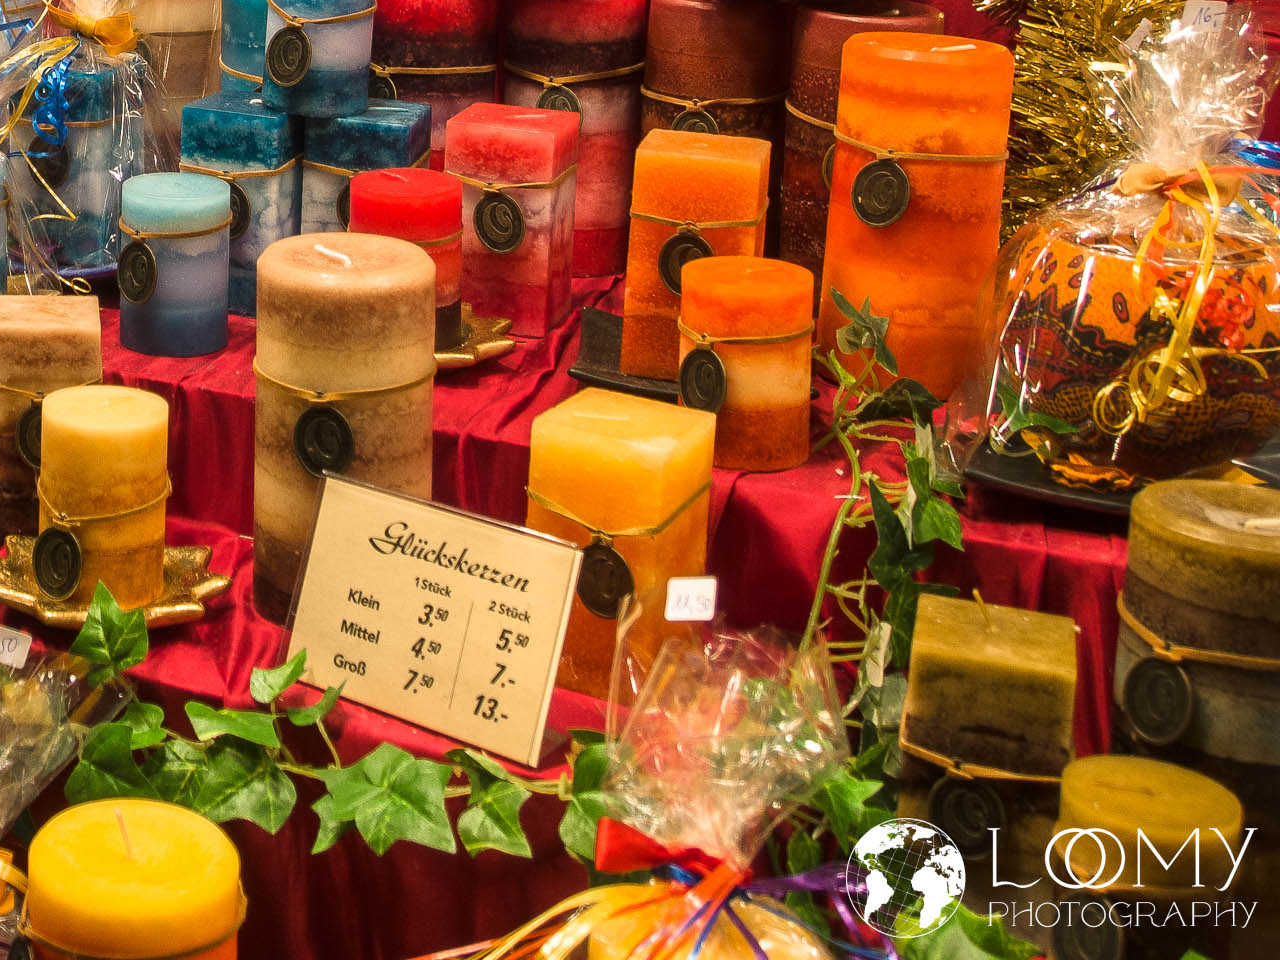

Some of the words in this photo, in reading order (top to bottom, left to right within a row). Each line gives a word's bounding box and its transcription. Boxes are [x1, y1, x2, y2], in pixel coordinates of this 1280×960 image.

[368, 521, 531, 593] Glückskerzen
[347, 588, 381, 612] Klein
[415, 577, 421, 588] 1
[421, 578, 453, 599] Stück
[488, 601, 497, 613] 2
[498, 603, 532, 624] Stück
[340, 619, 381, 646] Mittel
[333, 653, 367, 677] Groß
